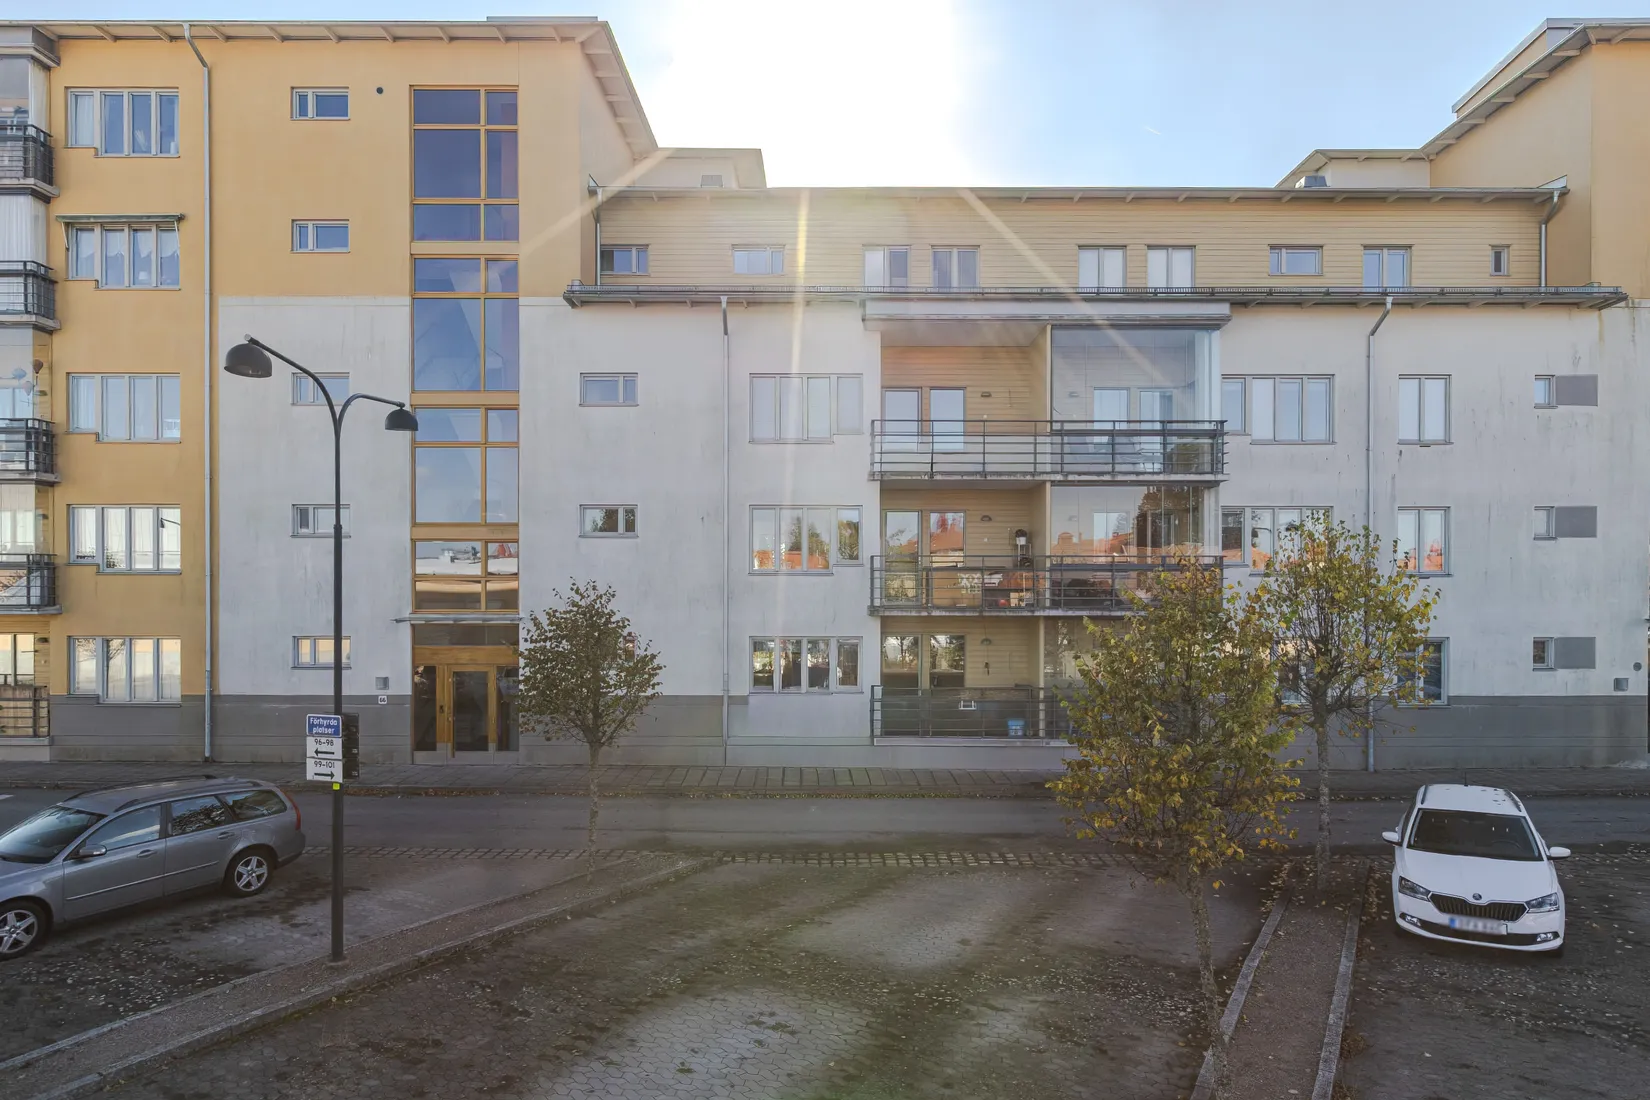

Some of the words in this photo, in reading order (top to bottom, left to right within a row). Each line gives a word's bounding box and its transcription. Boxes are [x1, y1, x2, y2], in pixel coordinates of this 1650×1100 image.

[310, 717, 337, 726] Förhyrda
[313, 726, 335, 734] platser
[314, 738, 334, 746] 96-98
